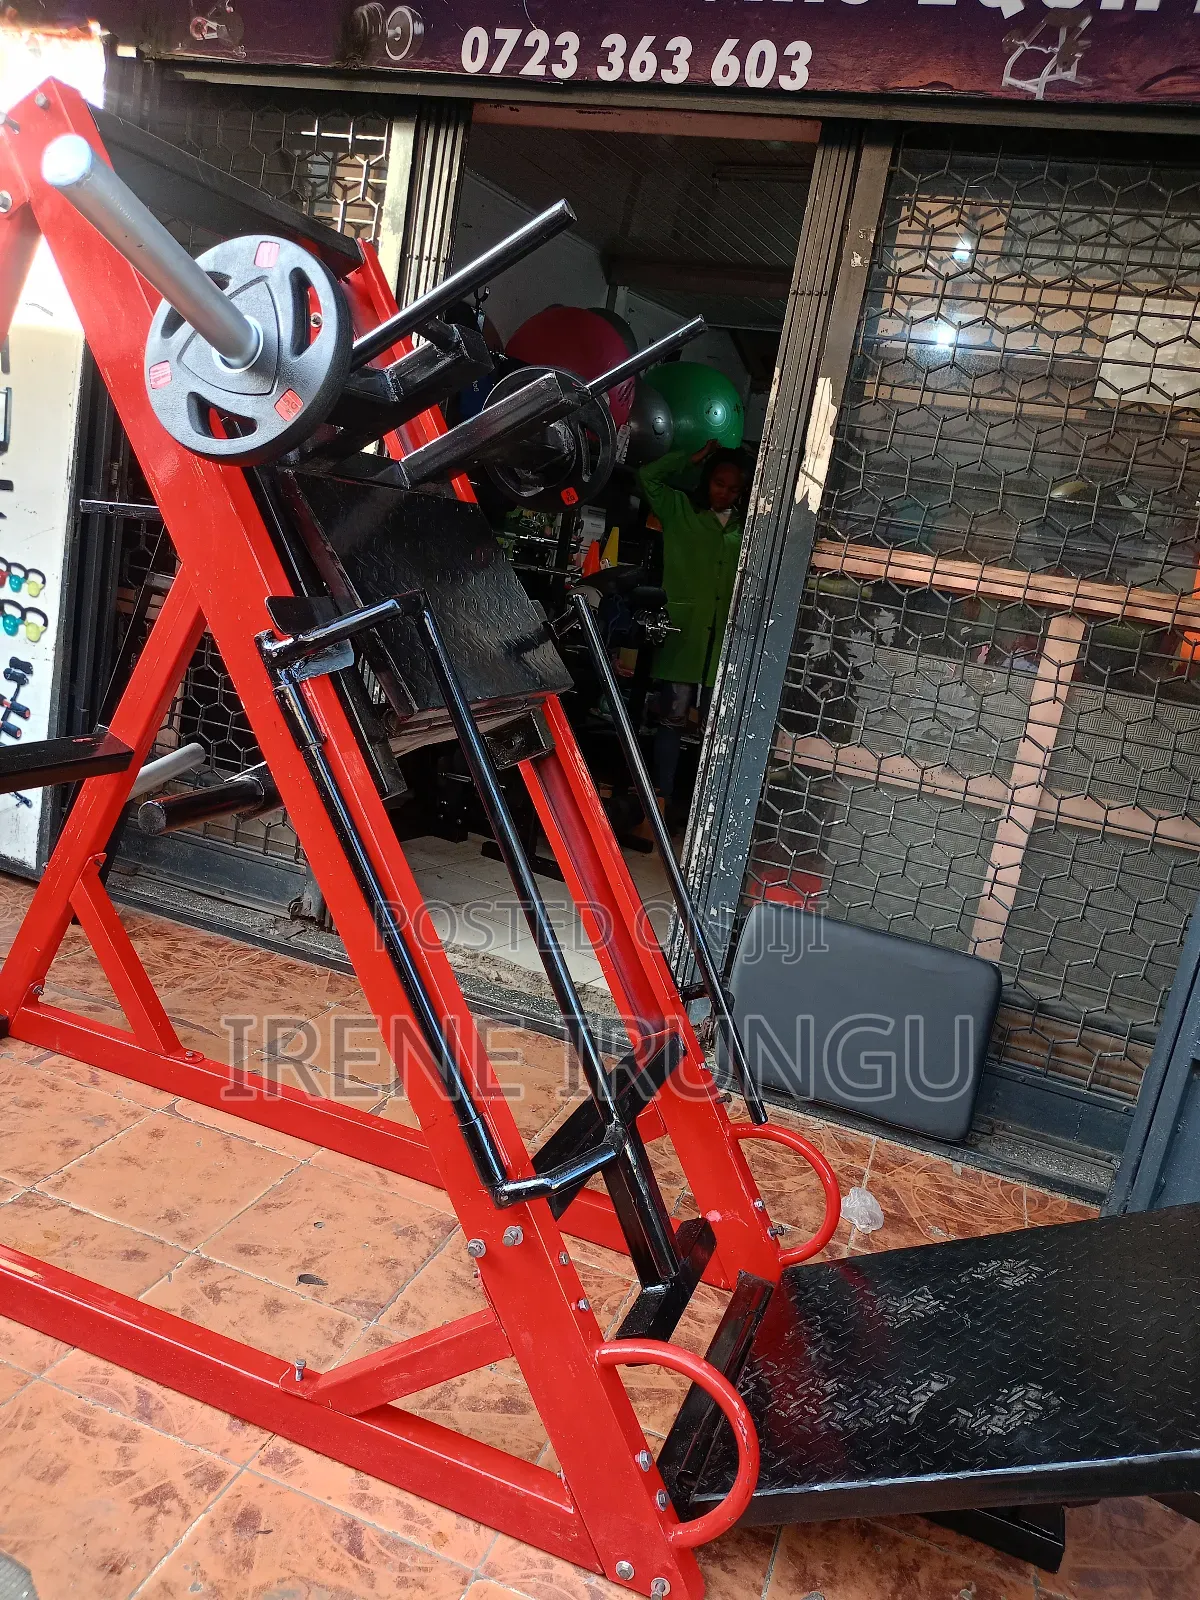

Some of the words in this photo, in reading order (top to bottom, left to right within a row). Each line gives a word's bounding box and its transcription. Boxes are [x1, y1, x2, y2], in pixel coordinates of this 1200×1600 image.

[462, 27, 580, 79] 0723
[597, 34, 693, 85] 363
[710, 39, 813, 91] 603
